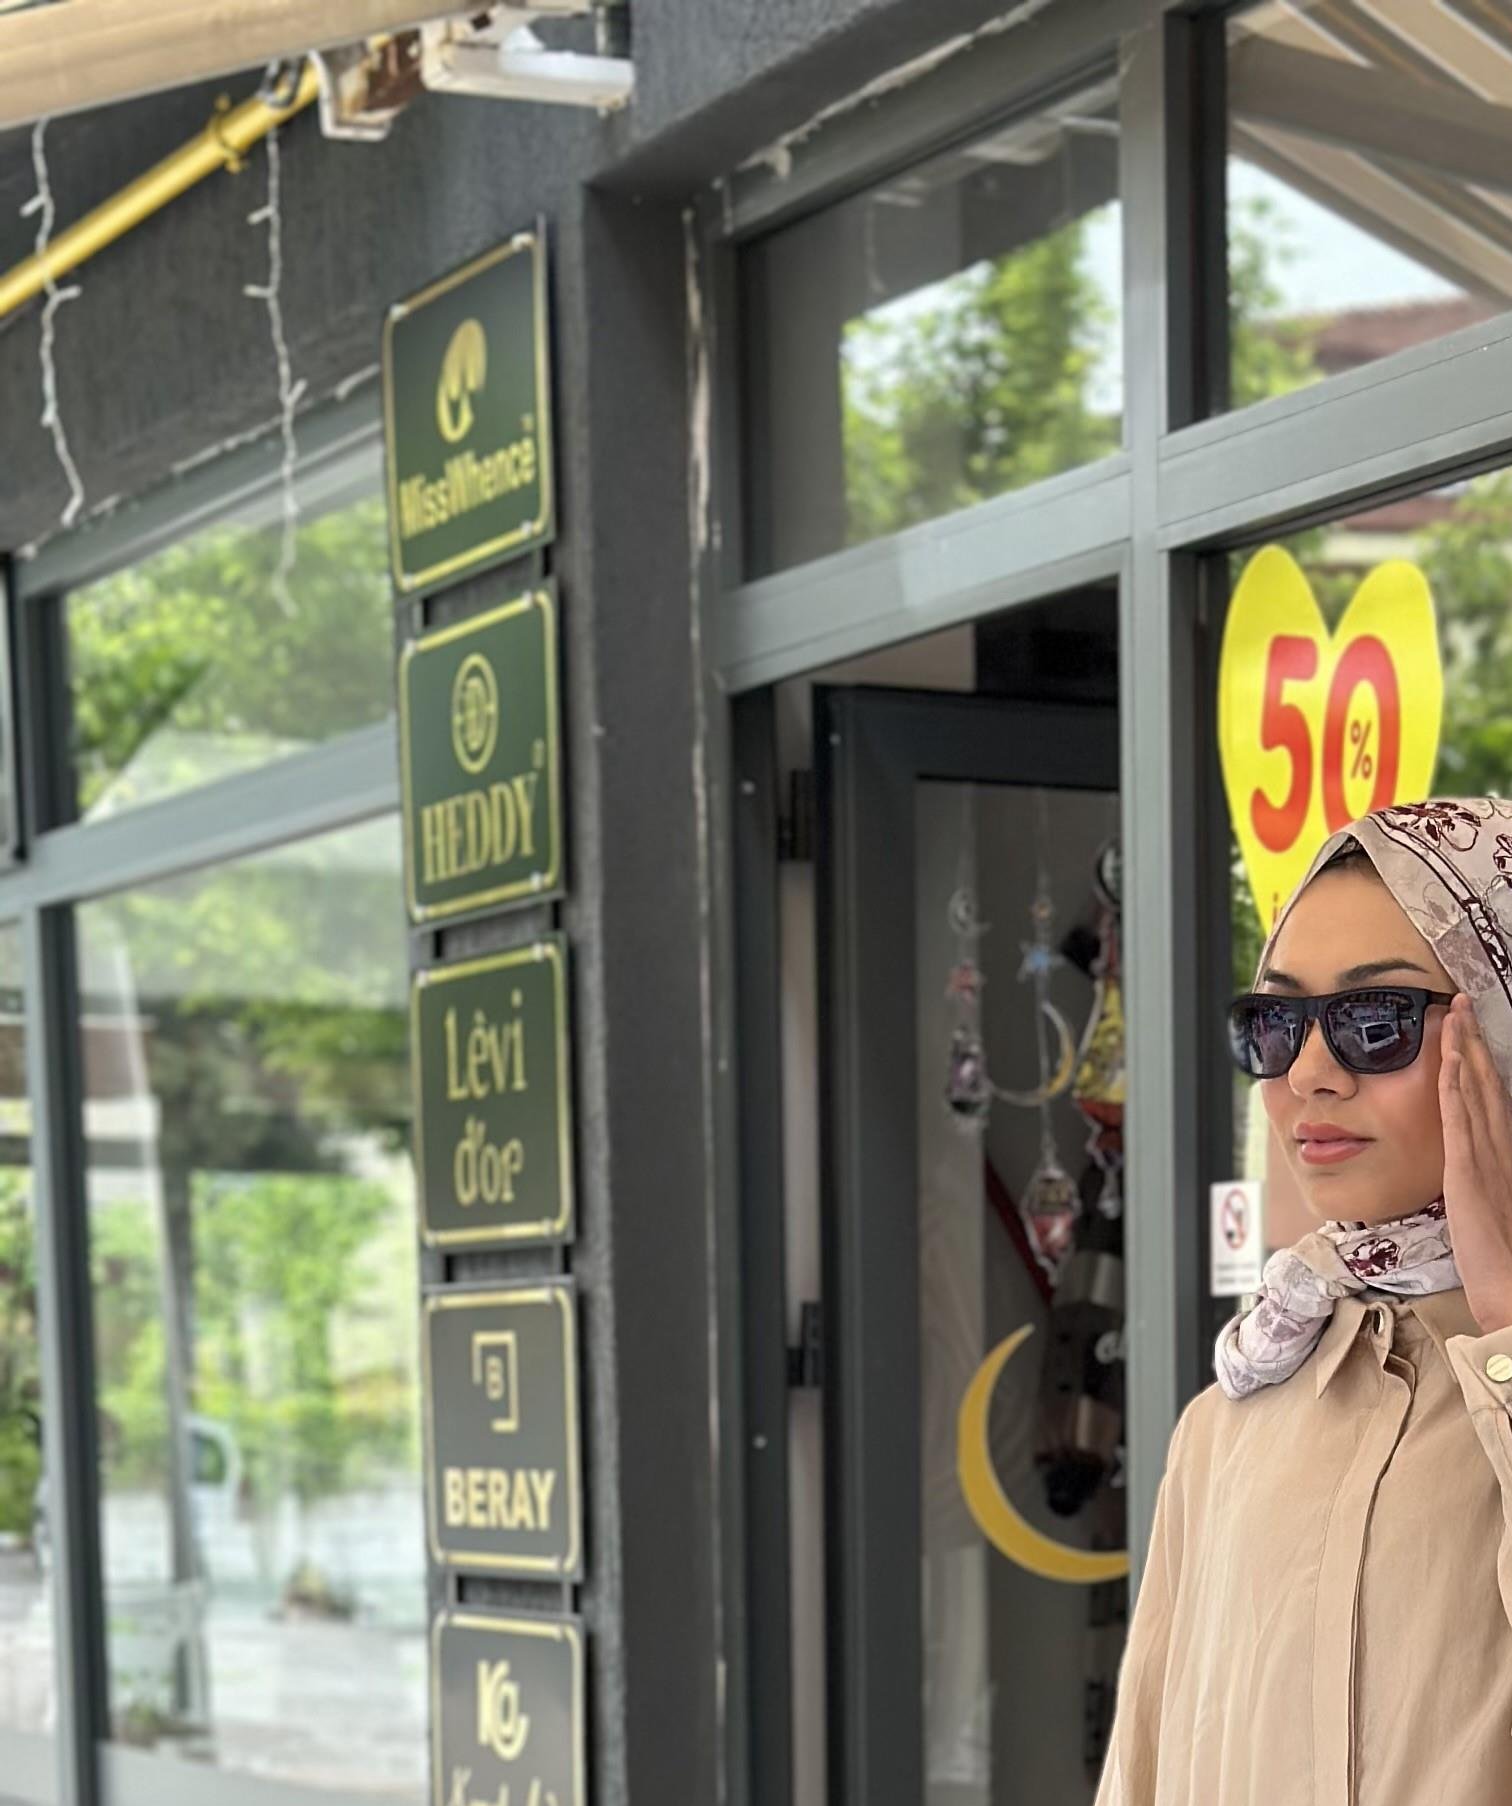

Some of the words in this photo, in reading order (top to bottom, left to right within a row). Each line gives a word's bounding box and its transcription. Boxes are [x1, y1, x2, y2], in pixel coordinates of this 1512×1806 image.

[1250, 634, 1400, 854] 50
[421, 772, 538, 884] HEDDY
[444, 1466, 556, 1531] BERAY
